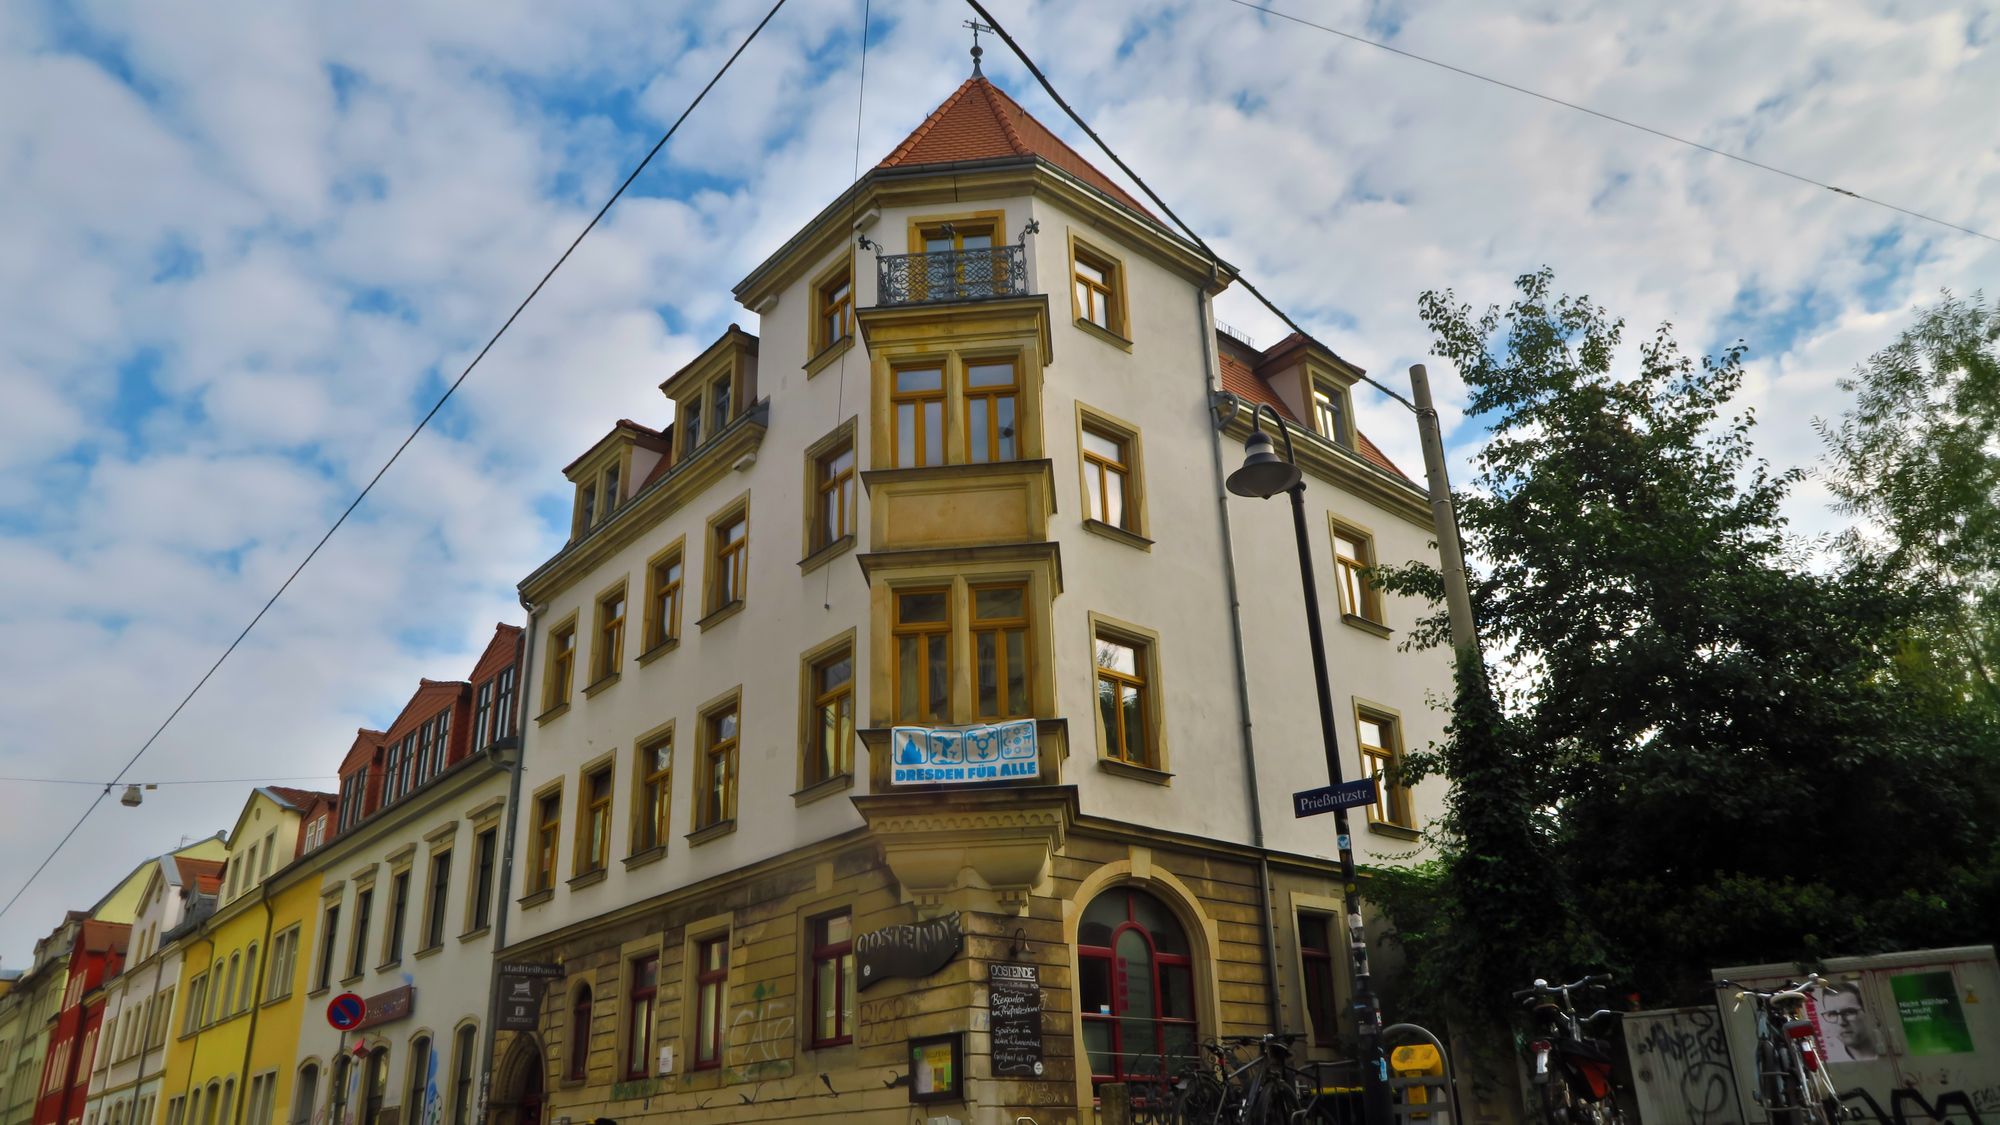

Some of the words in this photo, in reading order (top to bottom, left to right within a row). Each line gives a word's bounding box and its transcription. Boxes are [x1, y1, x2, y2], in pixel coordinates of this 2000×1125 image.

[895, 768, 964, 781] DRESDEN
[967, 764, 996, 779] FÜR
[1000, 762, 1036, 775] ALLE
[1300, 789, 1370, 811] Prießnitzstr.
[991, 993, 1026, 1007] Biergarten
